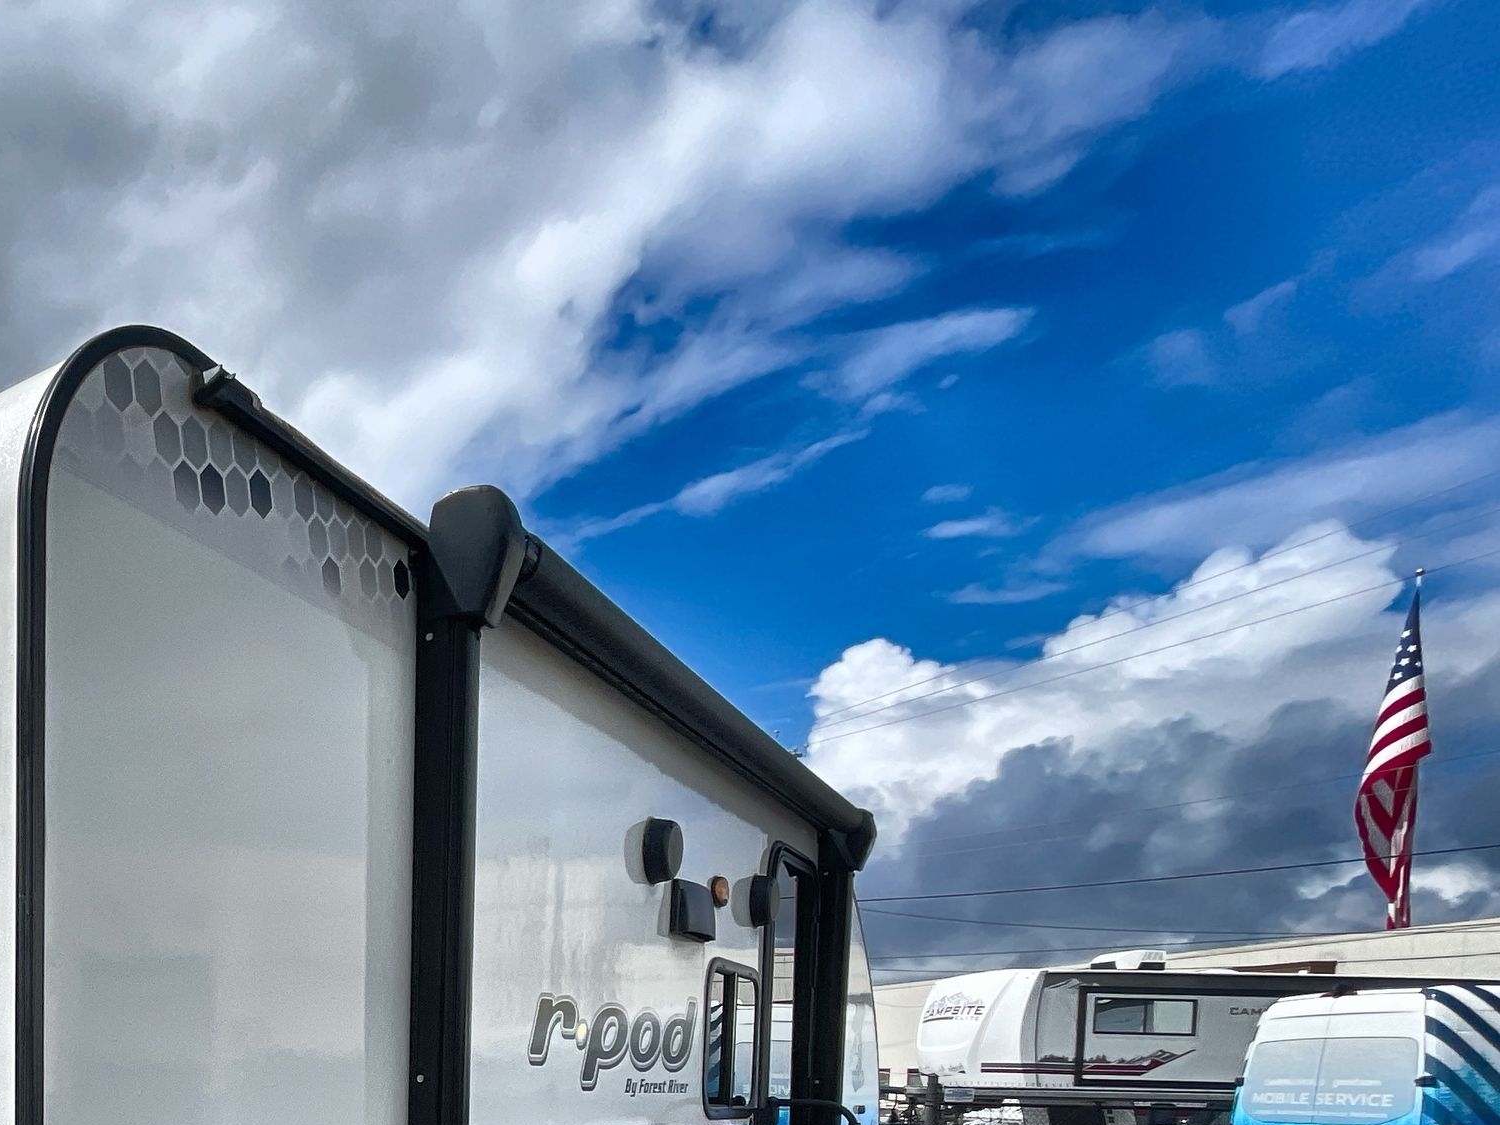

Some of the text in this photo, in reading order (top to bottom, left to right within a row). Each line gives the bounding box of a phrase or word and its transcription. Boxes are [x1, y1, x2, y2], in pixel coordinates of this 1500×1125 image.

[923, 1005, 985, 1020] CAMPSITE
[624, 1078, 689, 1097] By Forest River
[1252, 1092, 1395, 1107] MOBILE SERVICE
